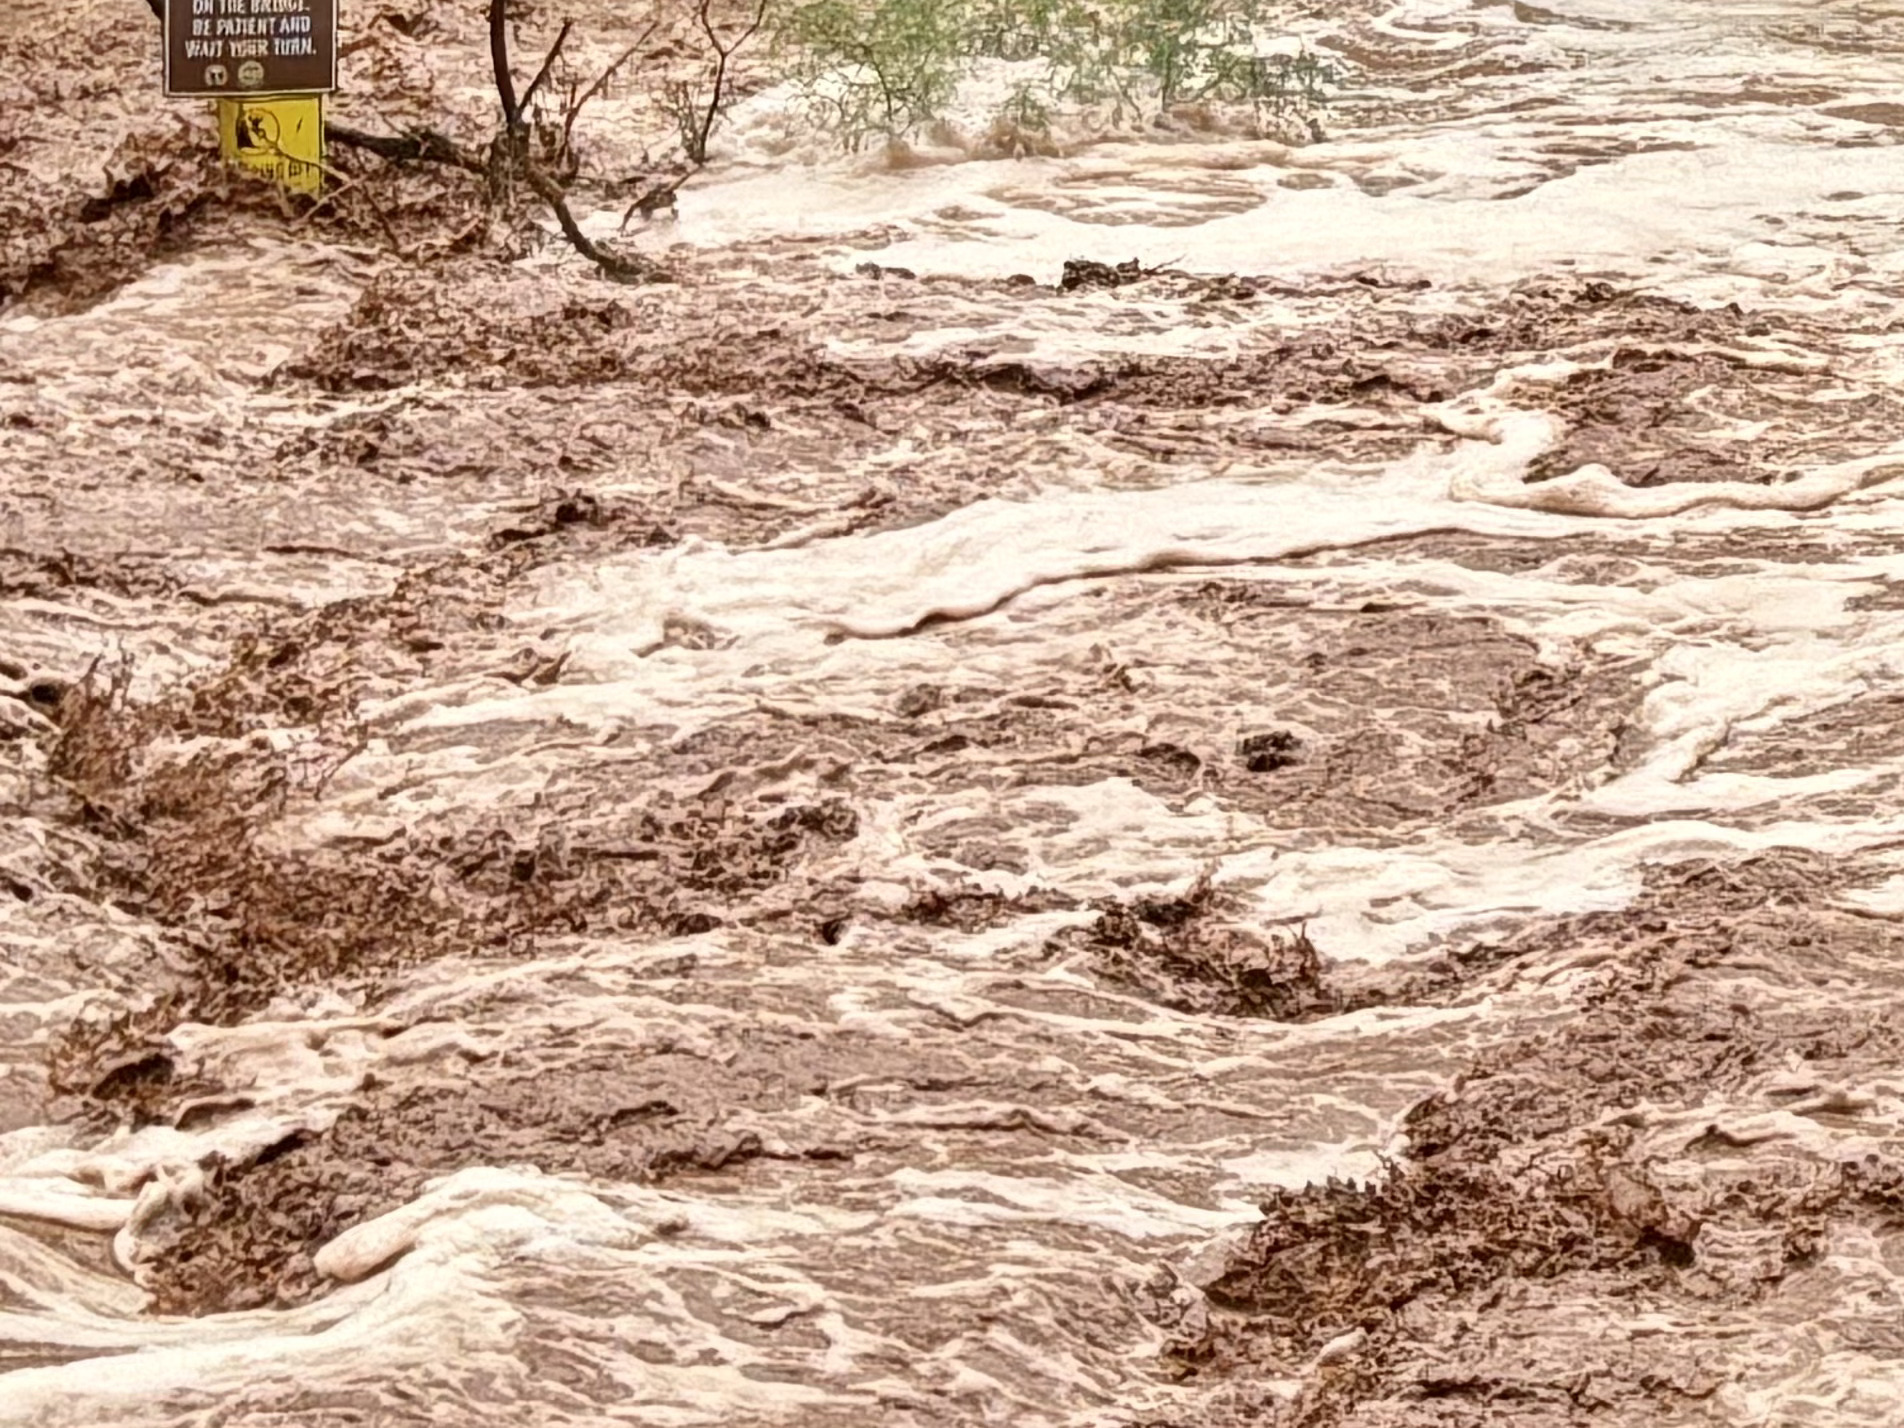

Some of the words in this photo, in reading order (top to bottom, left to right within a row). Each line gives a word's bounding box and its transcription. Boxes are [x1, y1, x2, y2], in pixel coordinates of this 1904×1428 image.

[193, 19, 211, 36] BE
[216, 17, 274, 36] PATIENT
[280, 16, 310, 33] AND
[185, 40, 222, 58] WAIT
[230, 40, 268, 58] YOUR
[274, 38, 316, 55] TURN.
